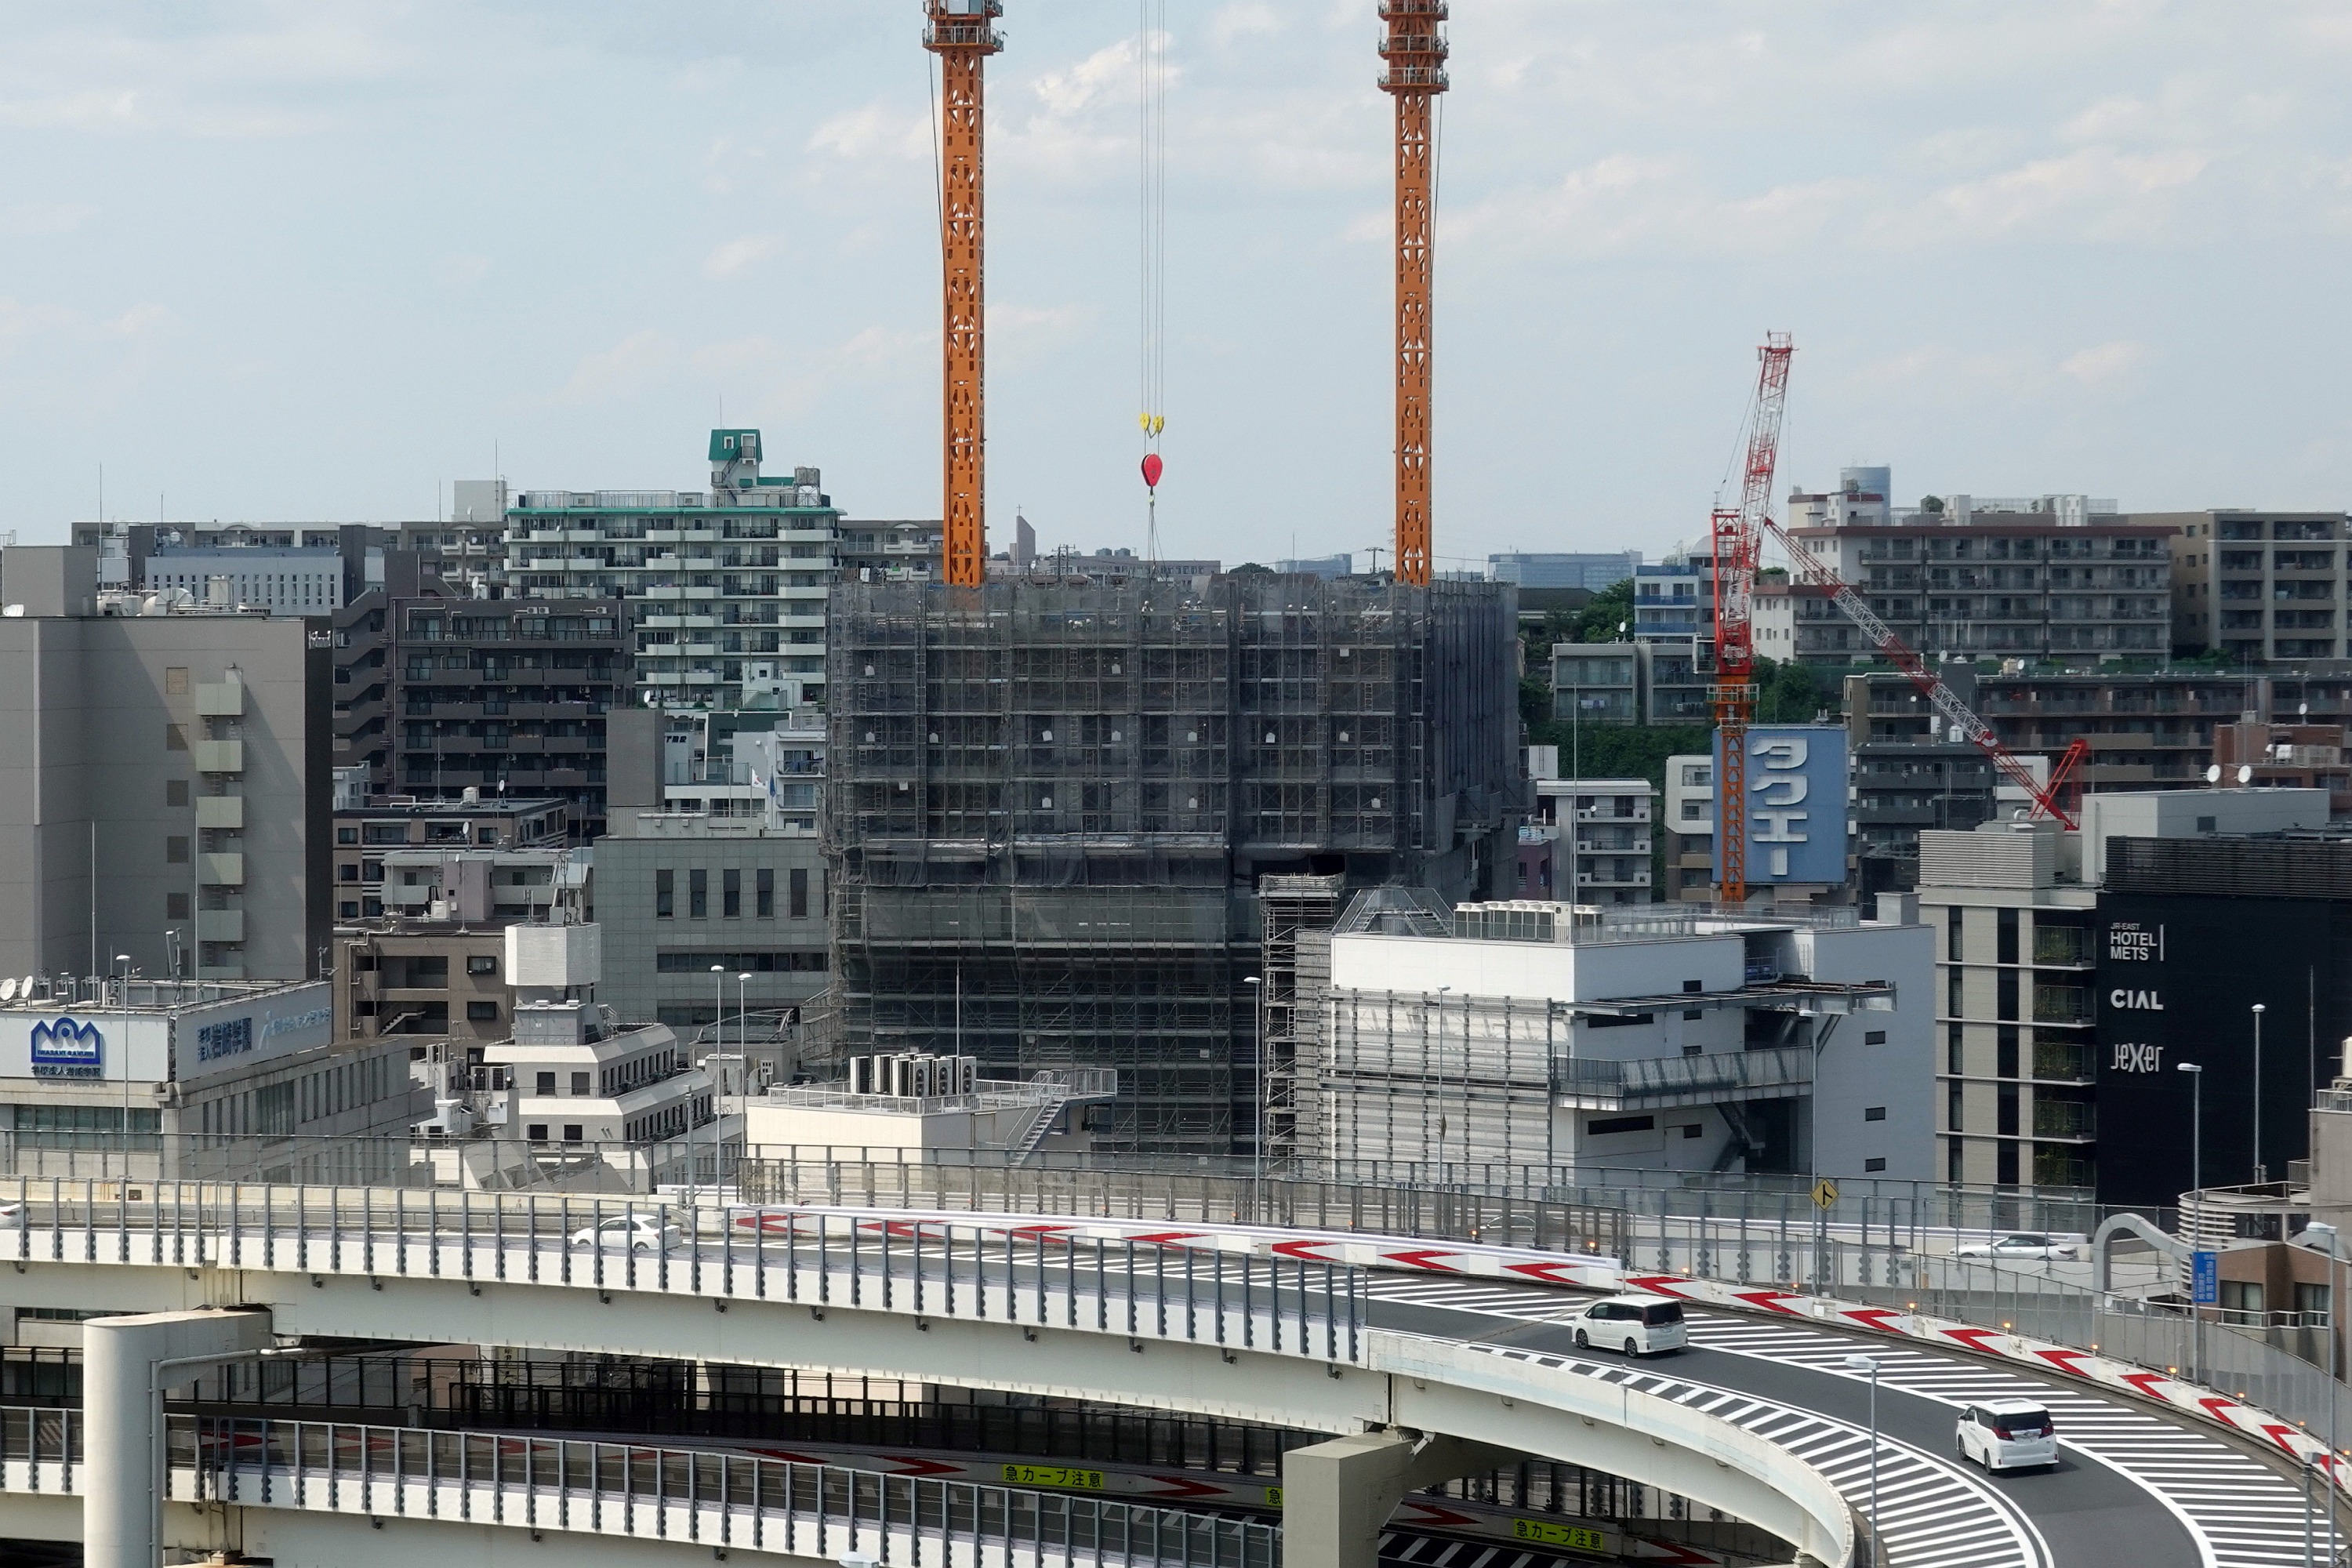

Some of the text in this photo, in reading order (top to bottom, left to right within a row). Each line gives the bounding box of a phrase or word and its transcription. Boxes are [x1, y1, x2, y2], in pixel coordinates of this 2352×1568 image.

[1750, 737, 1808, 876] タクエー
[2110, 931, 2158, 946] HOTEL
[2110, 946, 2150, 961] METS
[2110, 989, 2164, 1011] CIAL
[1005, 1465, 1101, 1488] 急カーブ注意
[1269, 1488, 1281, 1504] 急
[1516, 1520, 1602, 1550] 急カーブ注意
